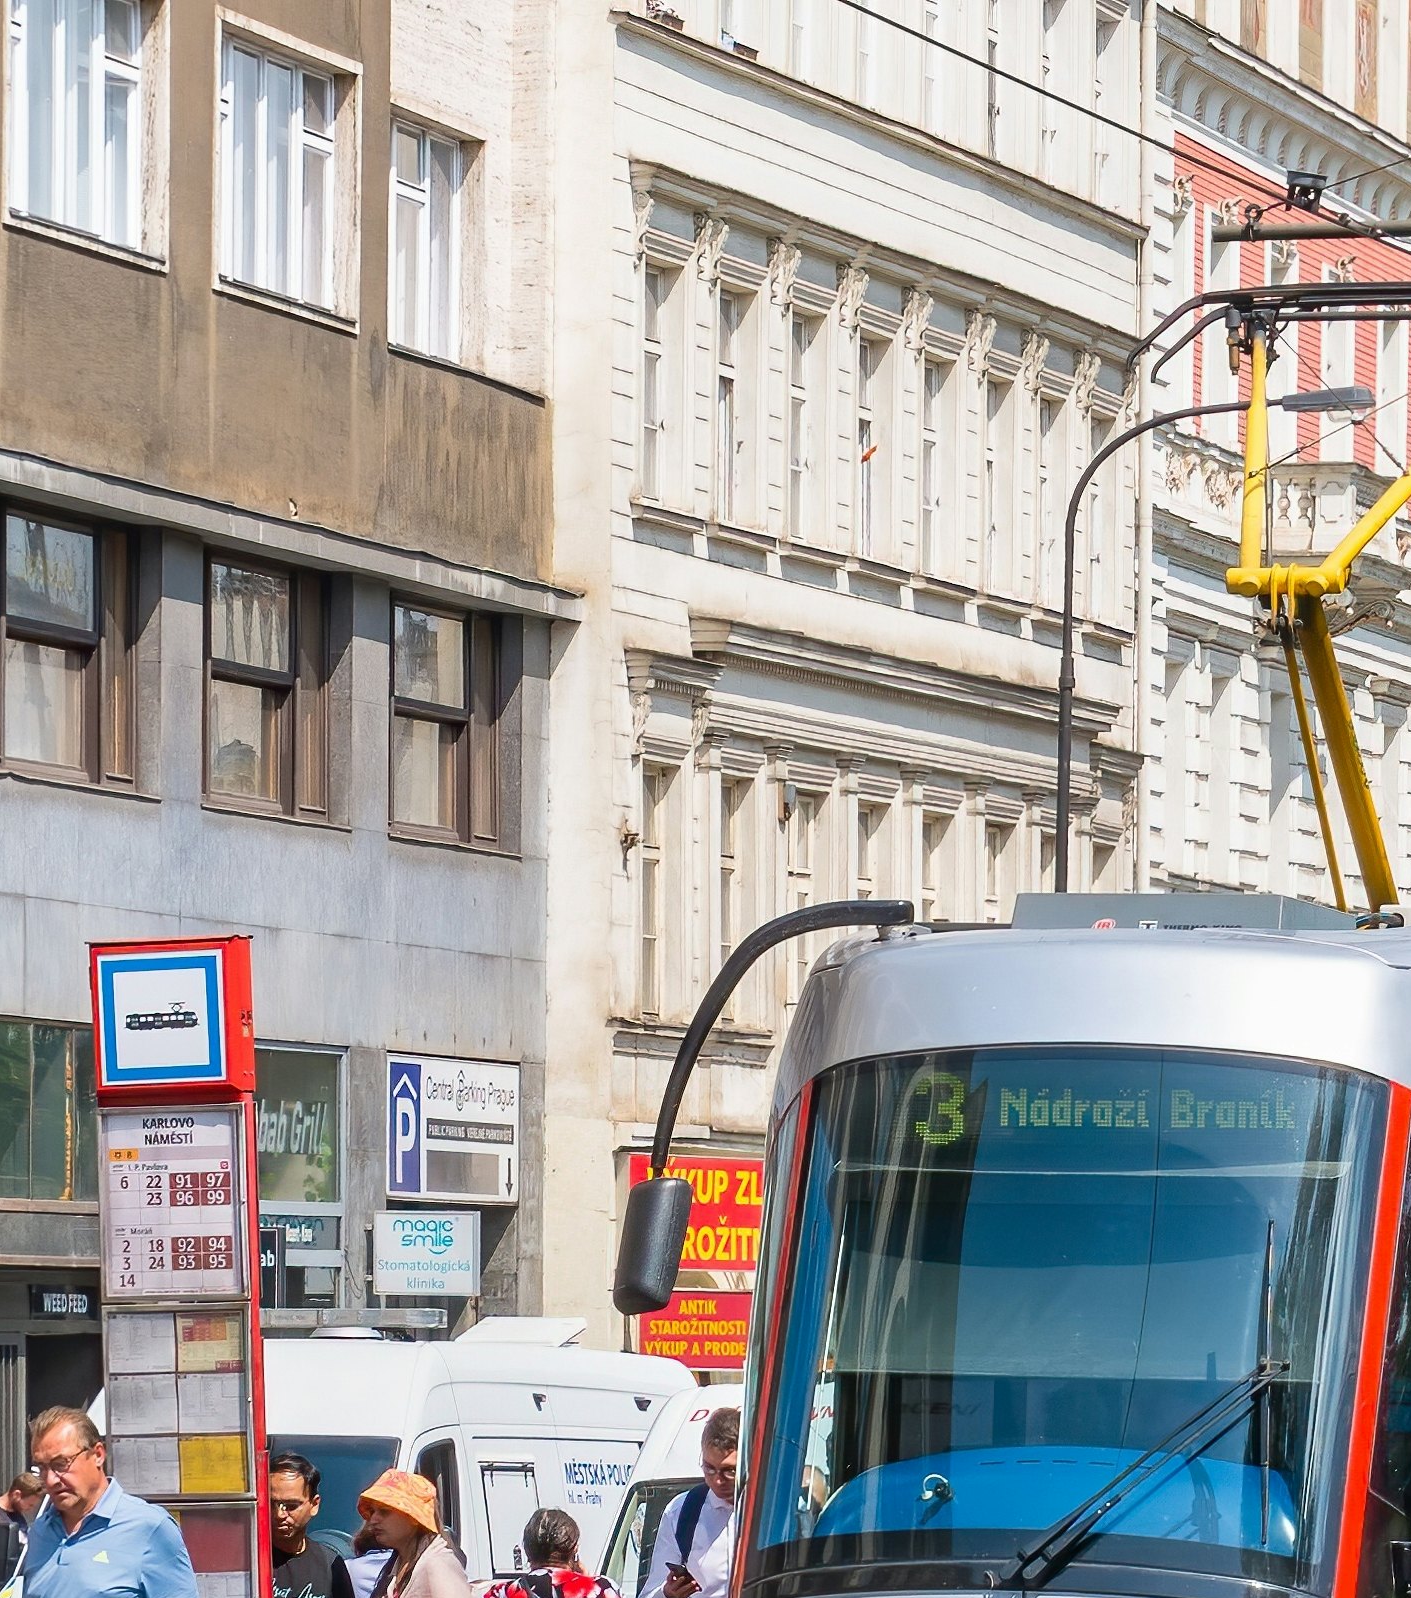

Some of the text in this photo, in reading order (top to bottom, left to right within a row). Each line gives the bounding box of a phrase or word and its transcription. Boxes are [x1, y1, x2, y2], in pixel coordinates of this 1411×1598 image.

[426, 1076, 454, 1101] Central
[488, 1082, 515, 1111] Prague
[915, 1072, 965, 1145] 3
[1000, 1087, 1150, 1128] Nádraží
[142, 1117, 194, 1129] KARLOVO
[290, 1101, 327, 1155] Grill
[395, 1096, 416, 1184] P
[120, 1173, 224, 1189] 6 22 91 97
[146, 1190, 225, 1206] 23 96 99
[393, 1219, 454, 1233] magic
[122, 1238, 226, 1253] 2 18 92 94
[401, 1233, 454, 1248] smile
[122, 1254, 226, 1270] 3 24 93 95
[377, 1260, 470, 1274] Stomatologická
[119, 1274, 136, 1288] 14
[406, 1276, 445, 1289] klinika
[42, 1293, 88, 1313] WEED FEED
[679, 1299, 717, 1315] ANTIK
[649, 1318, 746, 1336] STAROŽITNOSTI
[645, 1338, 688, 1356] VÝKUP
[691, 1341, 701, 1356] A
[564, 1458, 607, 1486] MĚSTSKÁ
